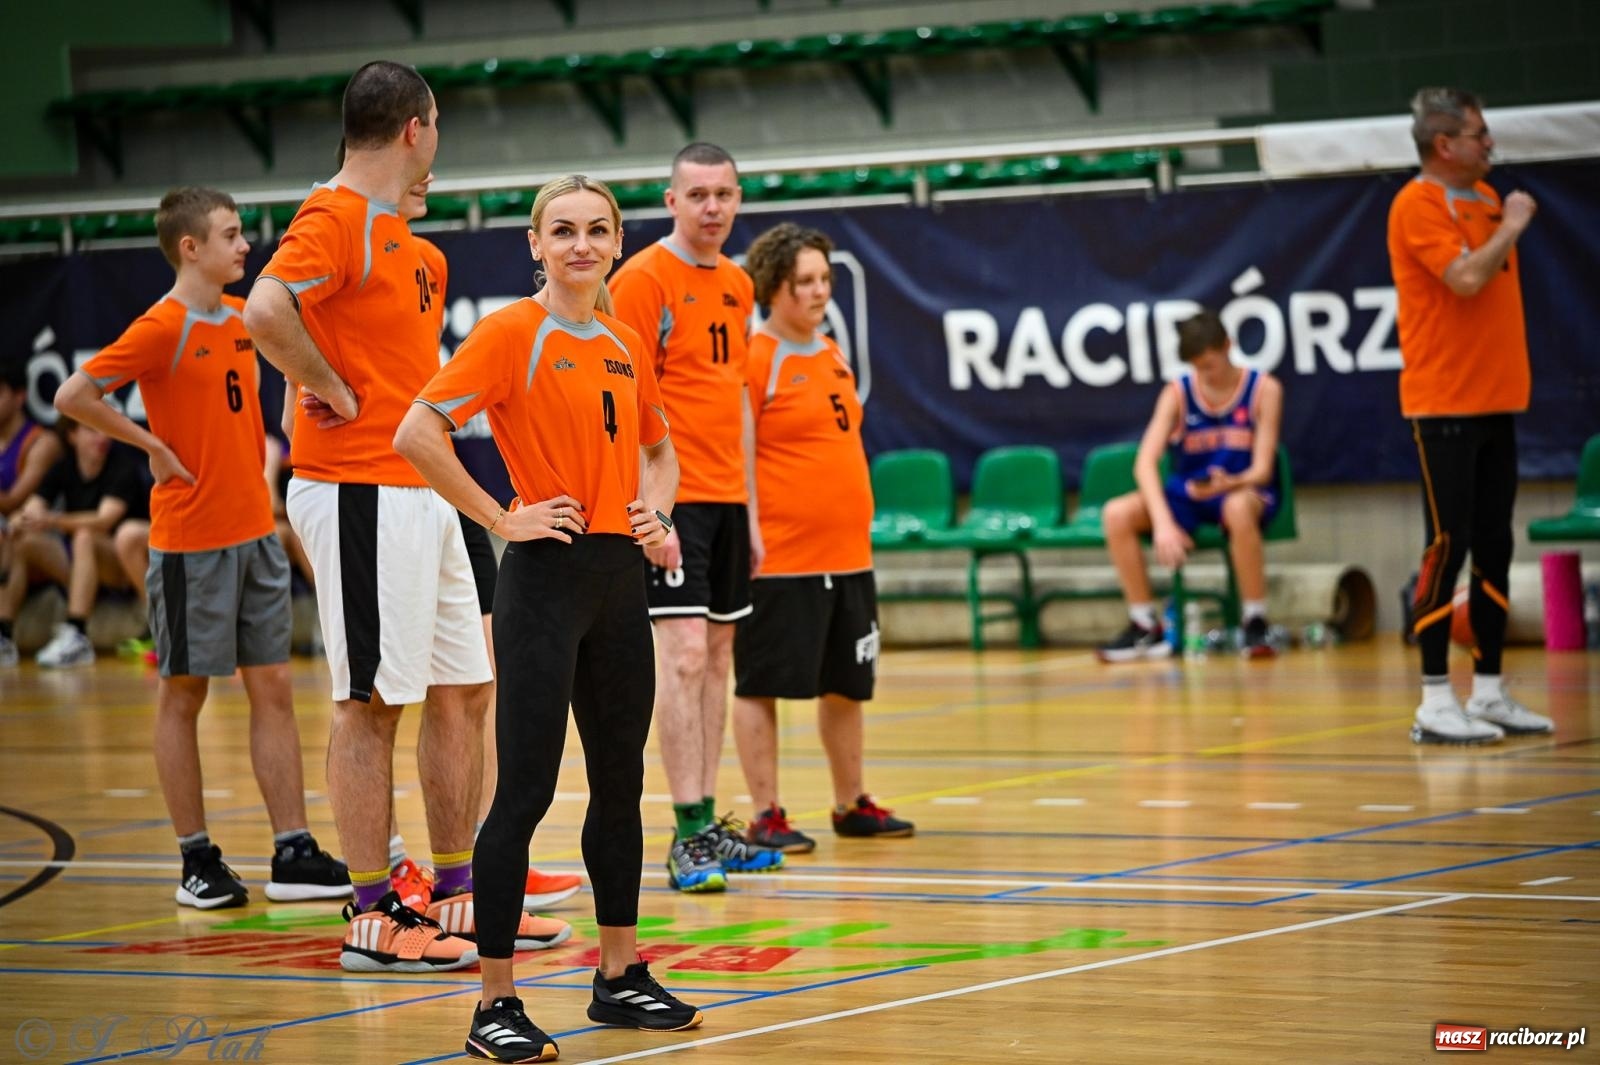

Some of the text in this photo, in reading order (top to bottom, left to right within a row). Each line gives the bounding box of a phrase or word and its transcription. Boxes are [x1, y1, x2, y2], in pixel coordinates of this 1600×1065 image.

[415, 267, 432, 313] 24
[708, 321, 729, 364] 11
[226, 369, 243, 413] 6
[829, 394, 850, 432] 5
[602, 390, 618, 443] 4
